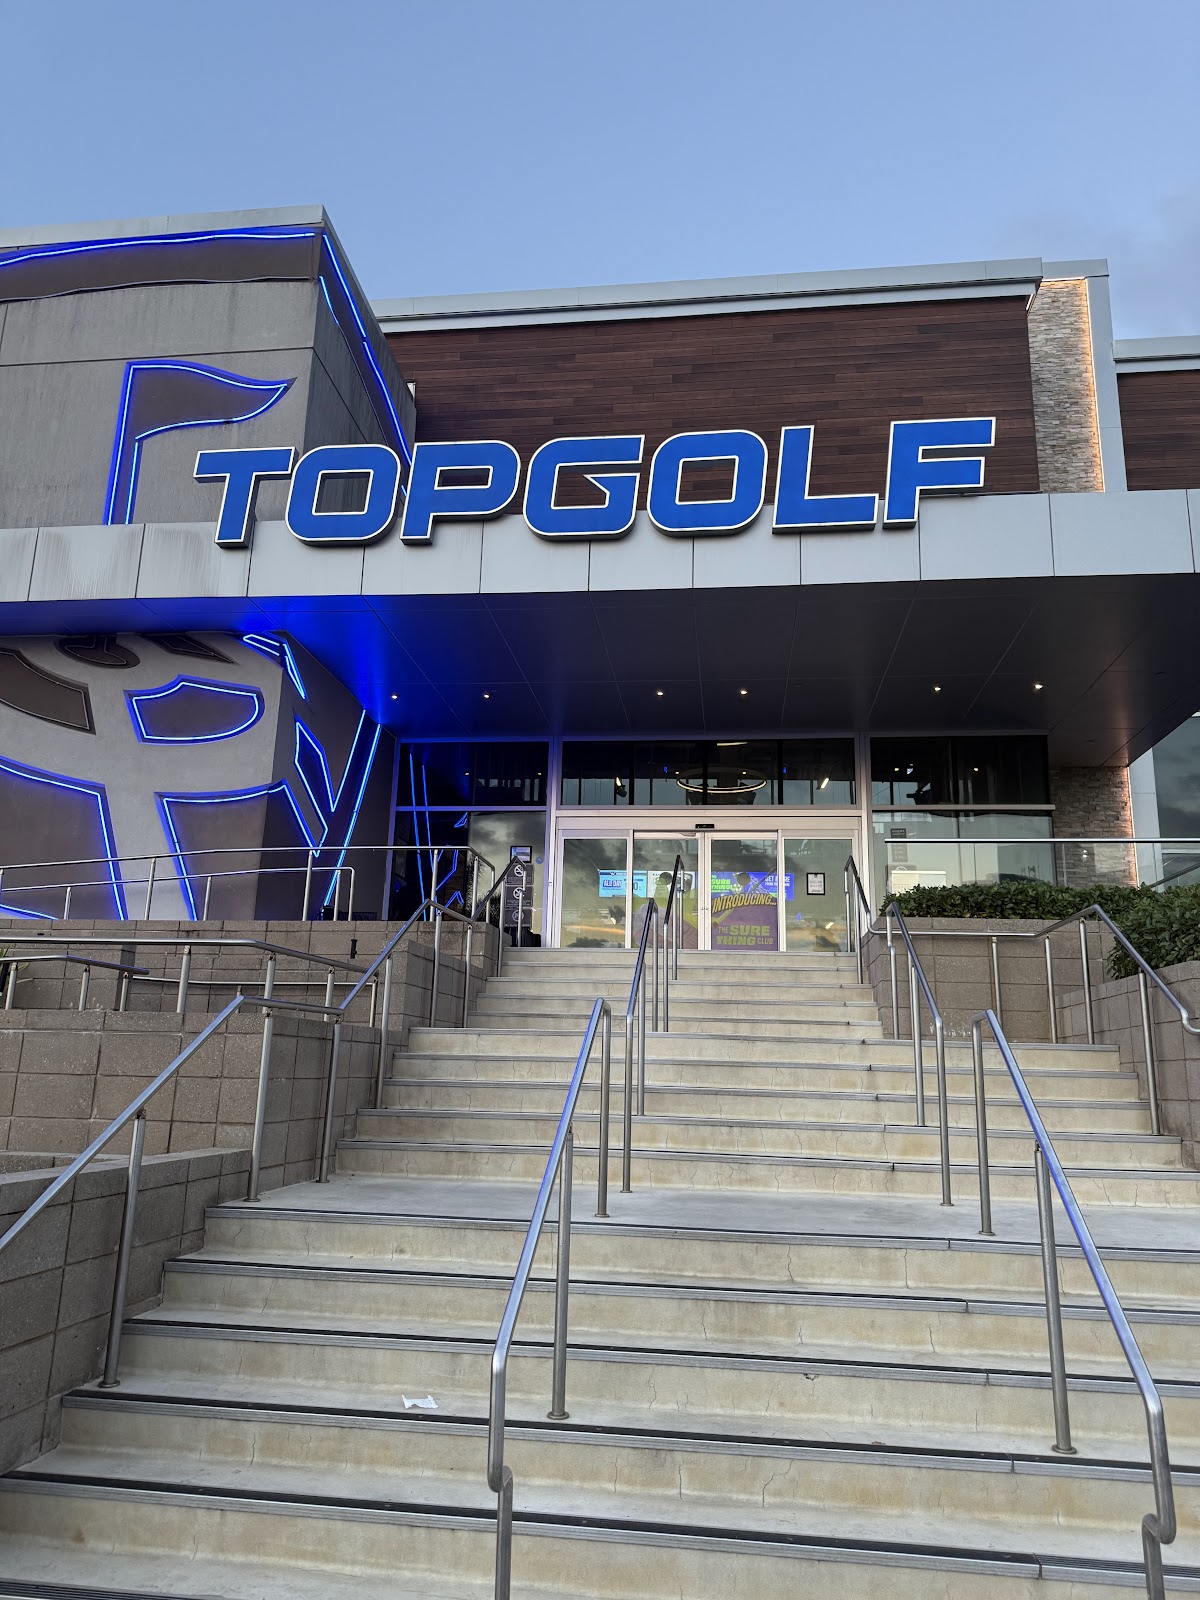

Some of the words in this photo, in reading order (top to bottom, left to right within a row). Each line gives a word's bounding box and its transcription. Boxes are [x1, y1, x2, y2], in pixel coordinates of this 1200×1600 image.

[194, 415, 998, 549] TOPGOLF
[718, 926, 729, 935] THE
[729, 924, 770, 936] SURE
[716, 935, 756, 946] THING
[757, 937, 774, 945] CLUB
